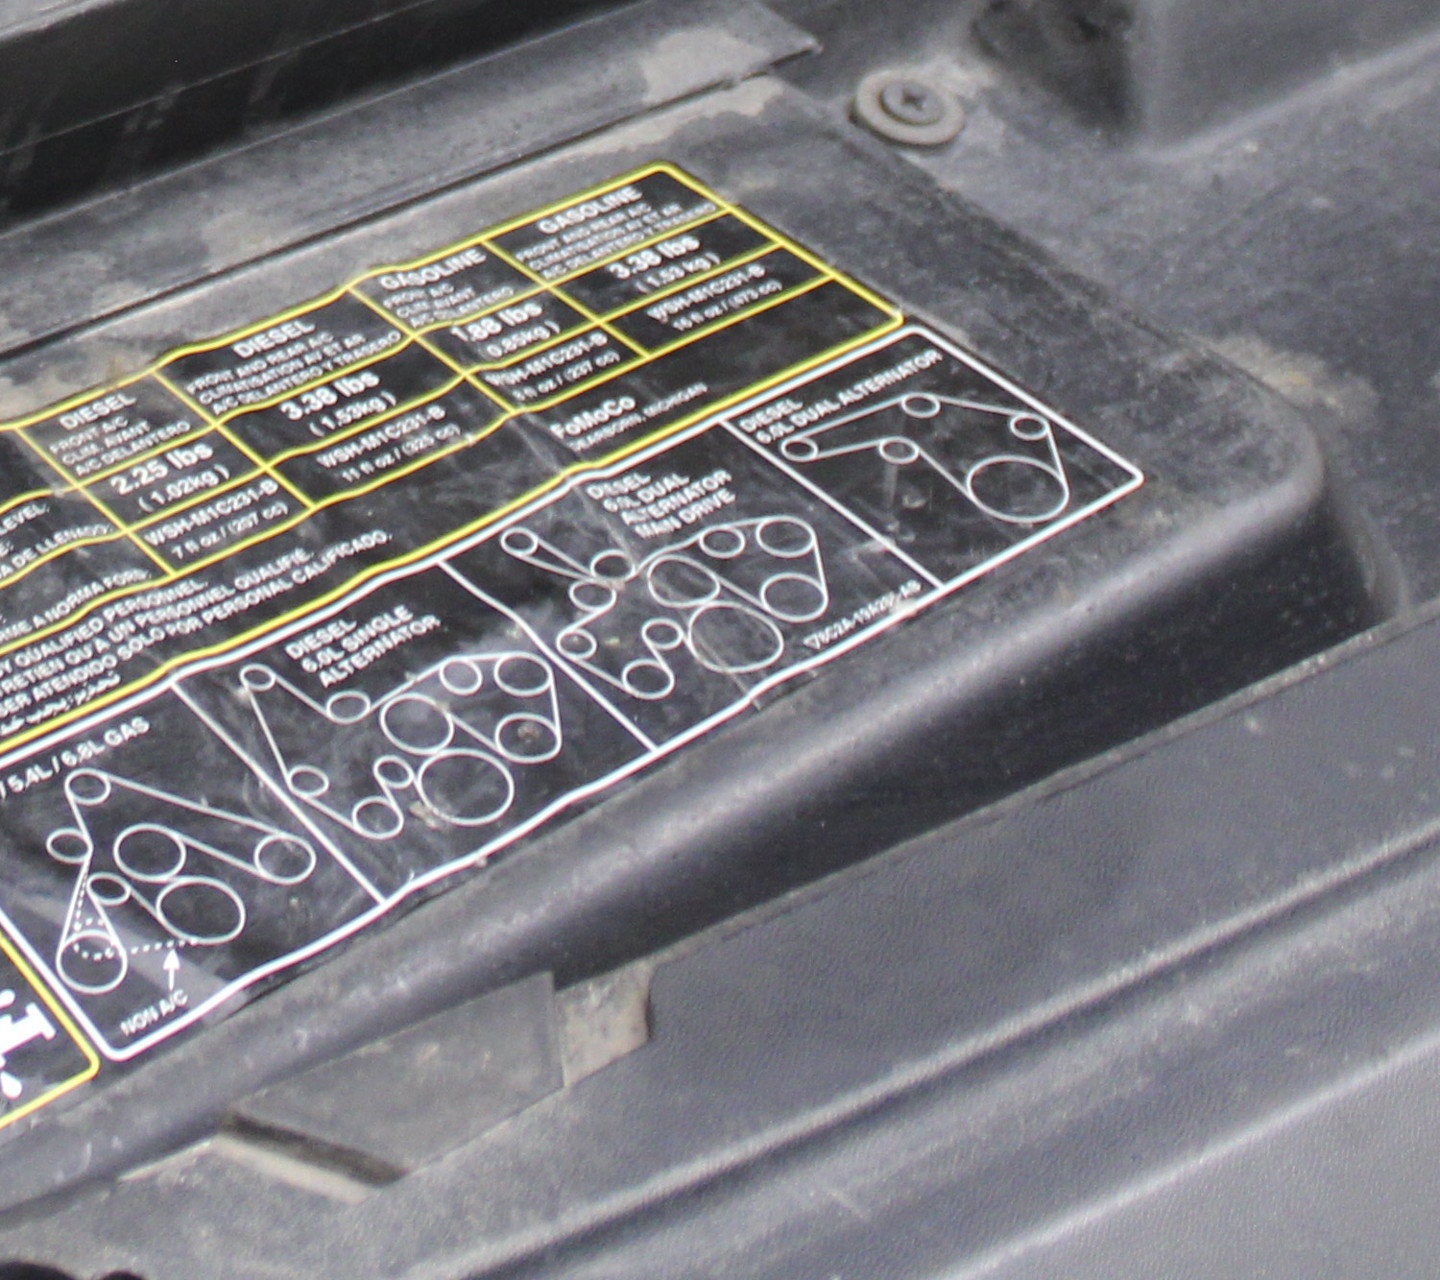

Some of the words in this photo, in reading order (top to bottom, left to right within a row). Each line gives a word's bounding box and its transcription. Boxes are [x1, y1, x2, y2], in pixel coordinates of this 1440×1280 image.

[538, 186, 641, 233] GASOLINE
[378, 243, 485, 297] GASOLINE
[608, 249, 661, 278] 3.38
[656, 235, 699, 258] lbs
[498, 302, 542, 325] lbs
[233, 320, 314, 357] DIESEL
[59, 393, 136, 429] DIESEL
[280, 387, 337, 419] 3.38
[334, 371, 379, 396] lbs
[789, 399, 840, 426] DUAL
[838, 349, 942, 404] ALTERNATOR
[317, 405, 445, 467] WSH-M1C231-B
[549, 396, 635, 439] FoMoCo
[739, 399, 802, 432] DIESEL
[110, 459, 168, 494] 2.25
[166, 443, 213, 469] lbs
[636, 473, 689, 503] DUAL
[144, 479, 278, 545] WSH-M1C231-B
[678, 488, 735, 523] DRIVE
[11, 547, 44, 568] DE
[14, 616, 104, 666] QUALIFIED
[32, 653, 117, 700] ATENDIDO
[201, 578, 293, 624] PERSONAL
[285, 619, 356, 659] DIESEL
[301, 646, 345, 672] 6.0L
[335, 605, 413, 651] SINGLE
[309, 614, 440, 687] ALTERNATOR
[103, 716, 149, 746] GAS
[120, 1005, 164, 1035] NON
[158, 988, 188, 1015] A/C
